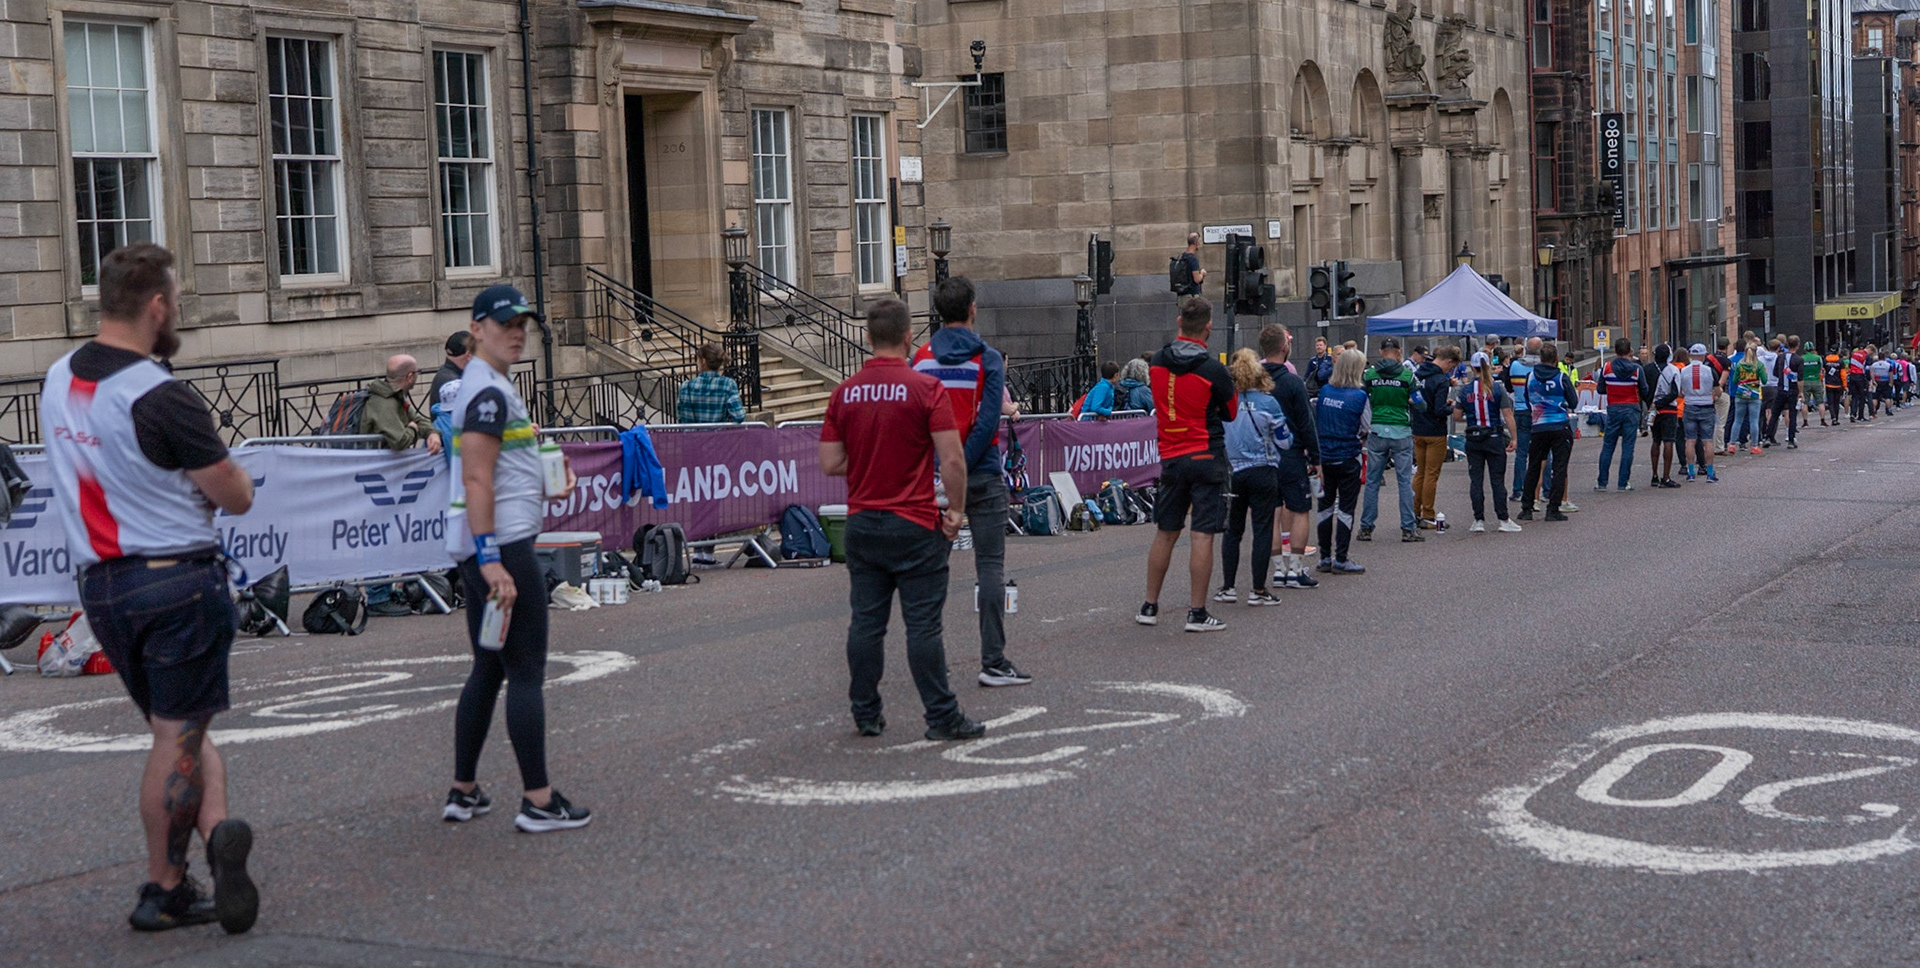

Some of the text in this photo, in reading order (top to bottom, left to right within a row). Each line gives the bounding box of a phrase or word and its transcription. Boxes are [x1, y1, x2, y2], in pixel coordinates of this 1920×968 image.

[662, 141, 686, 154] 206
[1846, 306, 1868, 316] 150
[1412, 318, 1477, 333] ITALIA
[332, 510, 448, 550] Peter Vard
[217, 525, 288, 564] Vardy
[3, 539, 78, 581] Vard
